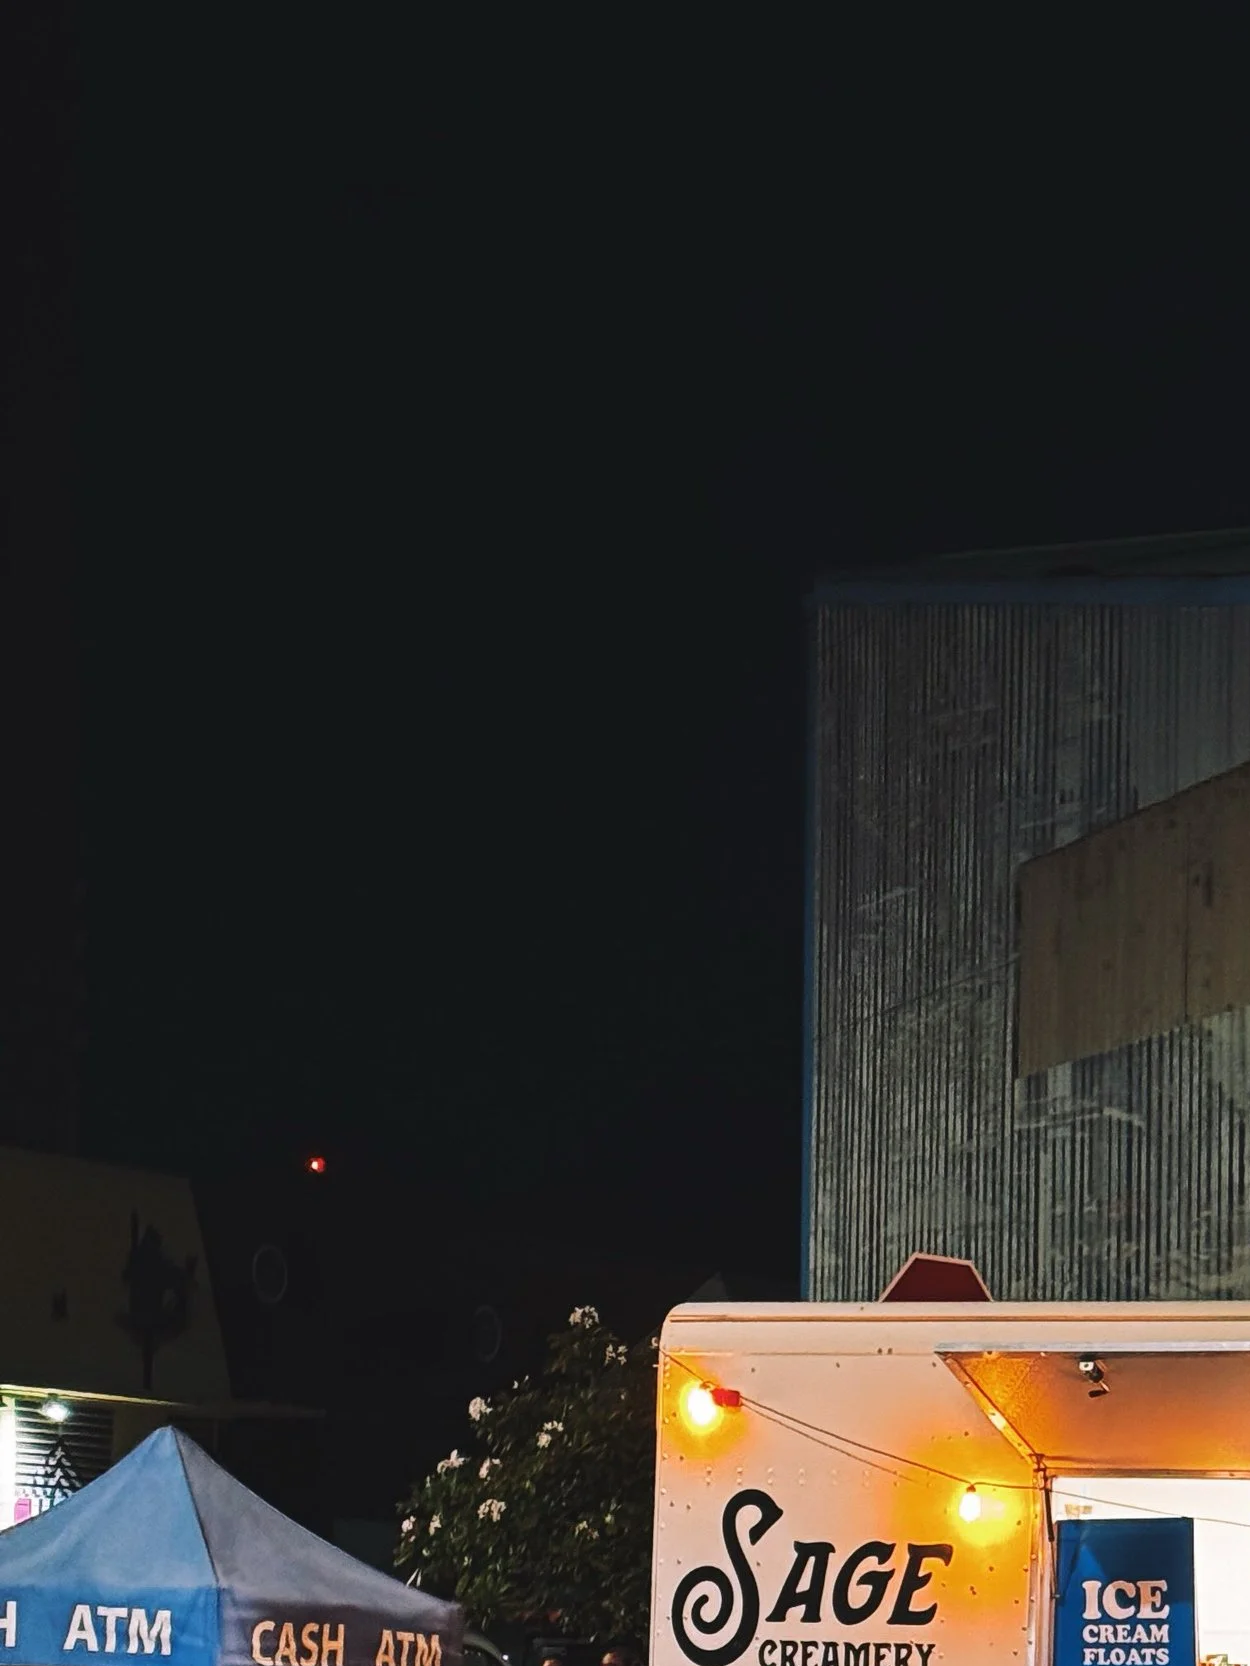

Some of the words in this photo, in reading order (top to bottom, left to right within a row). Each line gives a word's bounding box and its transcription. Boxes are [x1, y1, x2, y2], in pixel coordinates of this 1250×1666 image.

[1081, 1579, 1170, 1620] ICE
[63, 1604, 172, 1656] ATM
[1082, 1624, 1170, 1643] CREAM
[1082, 1647, 1170, 1666] FLOATS
